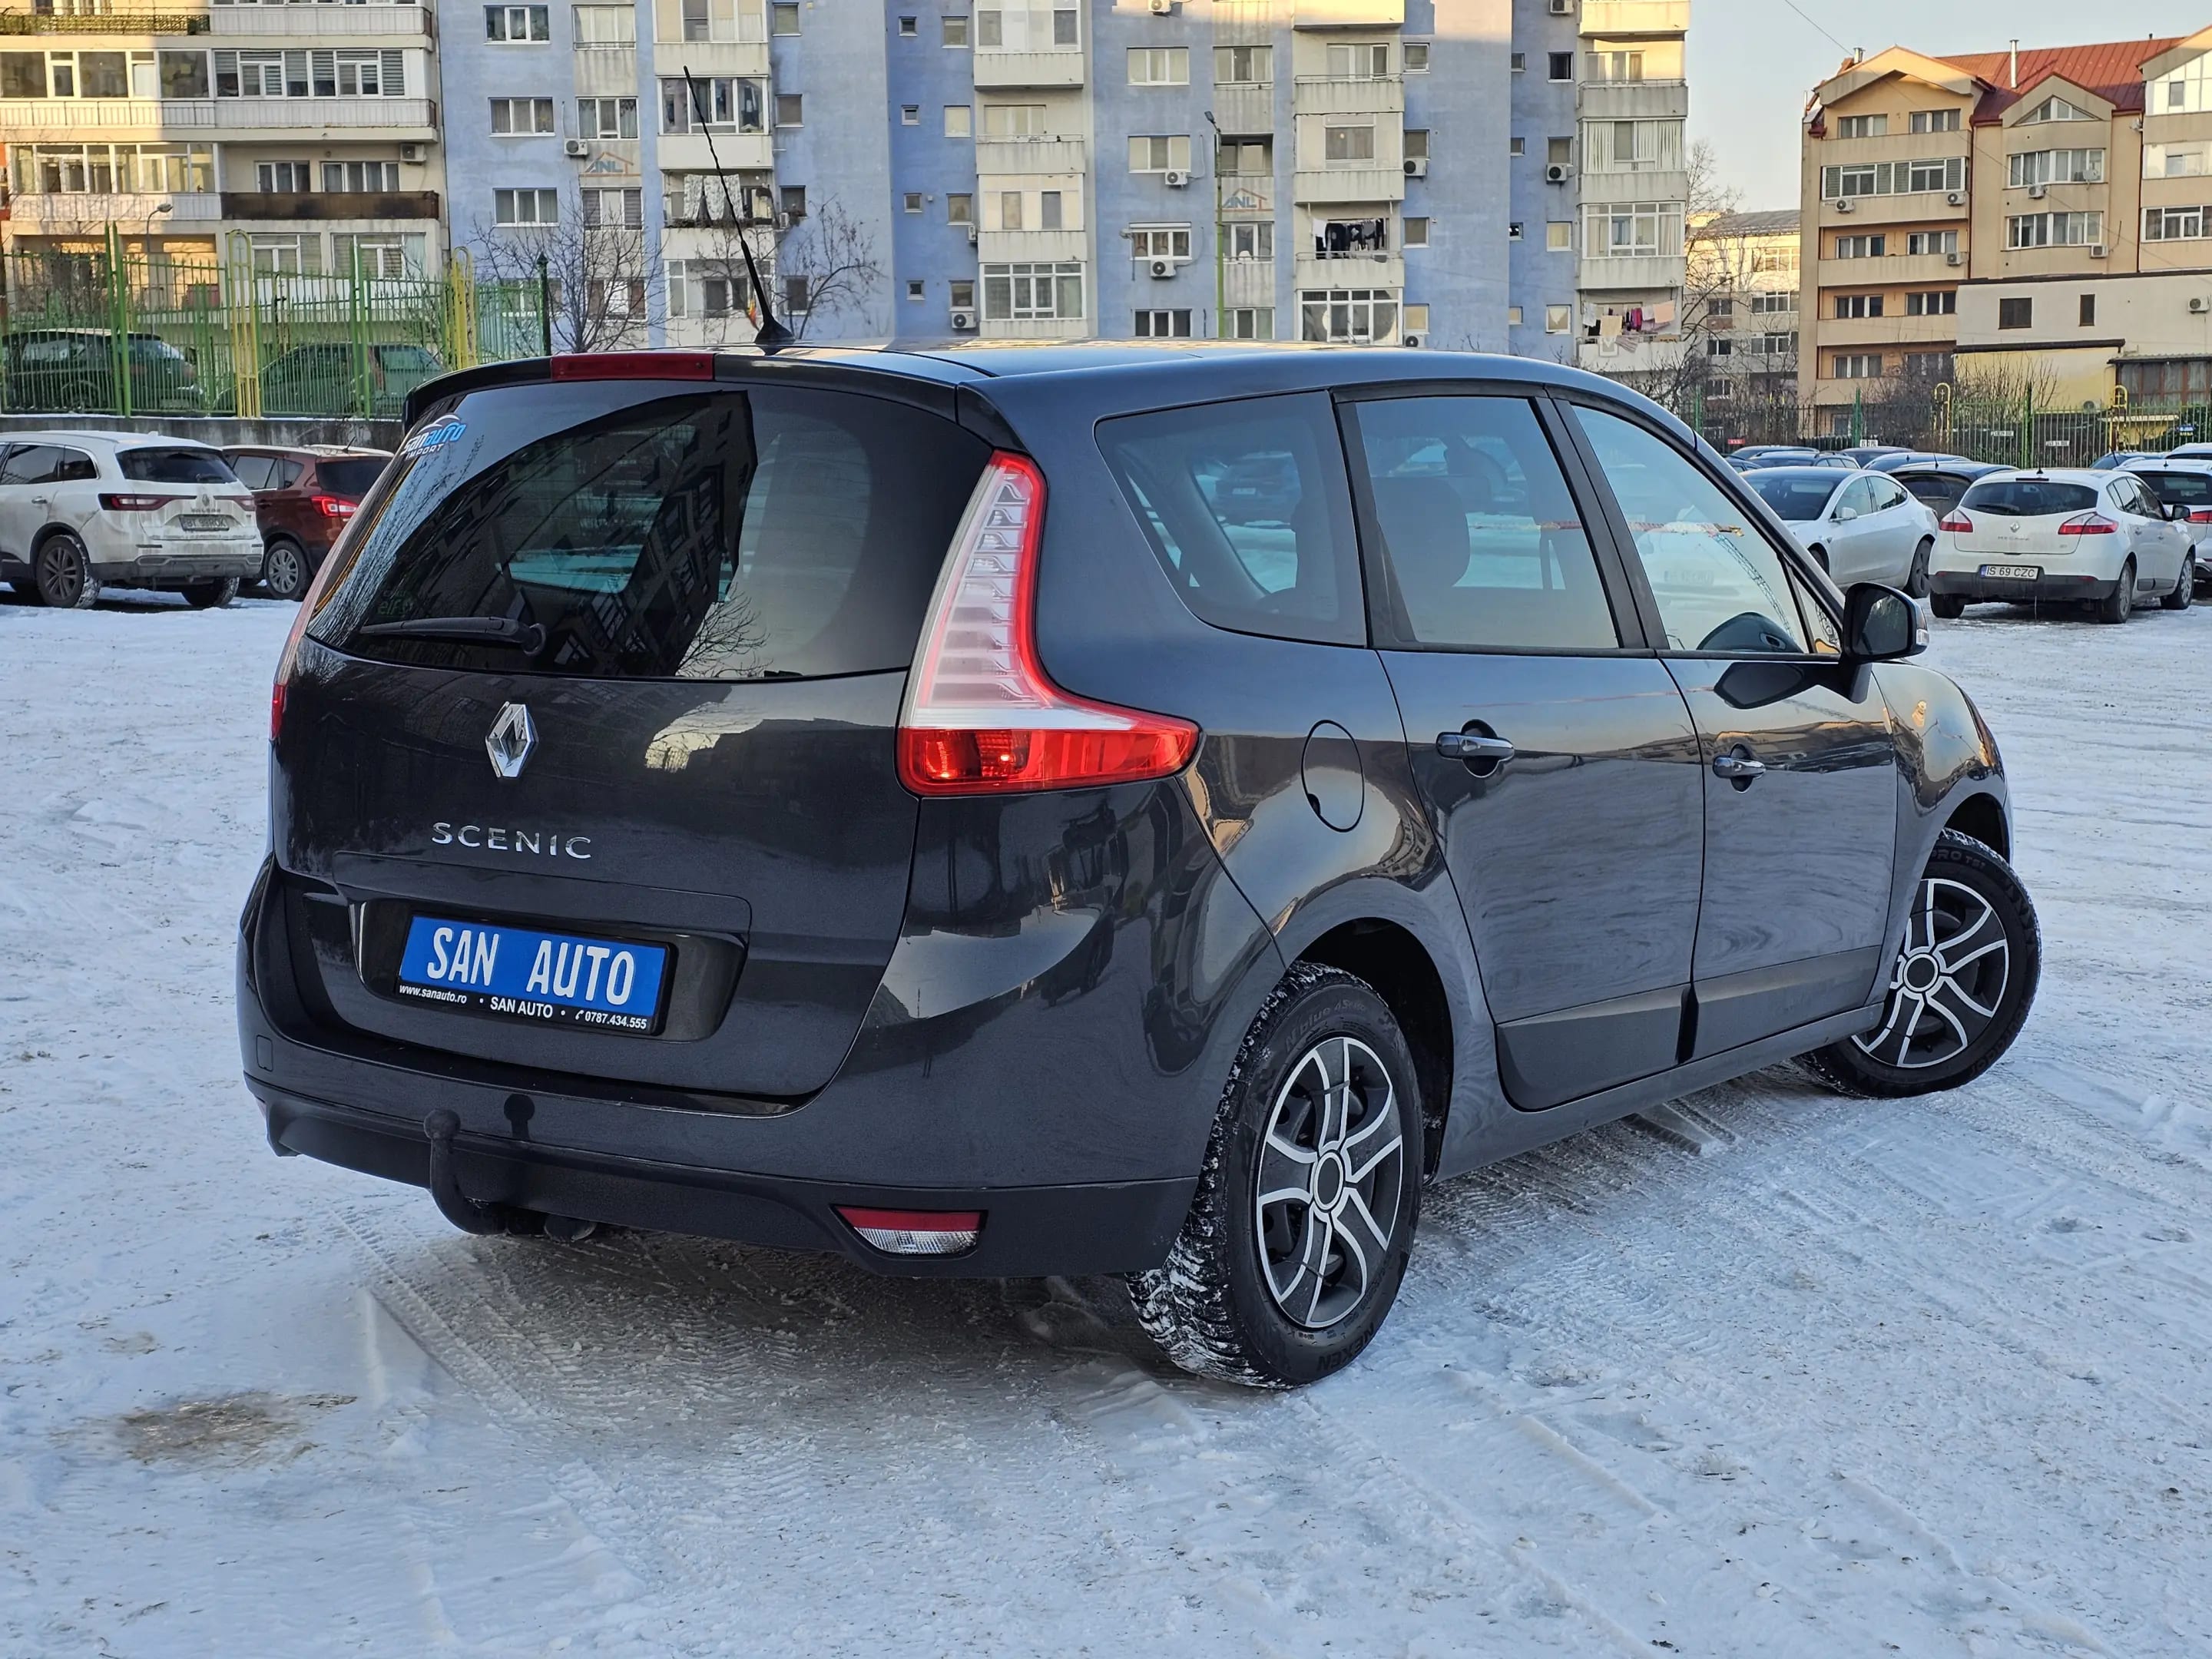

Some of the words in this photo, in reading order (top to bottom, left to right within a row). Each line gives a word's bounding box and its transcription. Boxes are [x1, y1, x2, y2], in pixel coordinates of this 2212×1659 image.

[406, 443, 445, 459] IMPORT
[1986, 566, 1997, 575] IS
[1999, 567, 2011, 576] 69
[2014, 568, 2035, 578] CZC
[432, 822, 591, 859] SCENIC
[426, 927, 499, 986] SAN
[526, 939, 635, 1005] AUTO
[399, 984, 467, 1005] www.sanauto.ro
[490, 996, 515, 1013] SAN
[518, 1001, 553, 1018] AUTO
[584, 1011, 647, 1030] 0787.434.555
[1317, 1322, 1375, 1371] NEXEN
